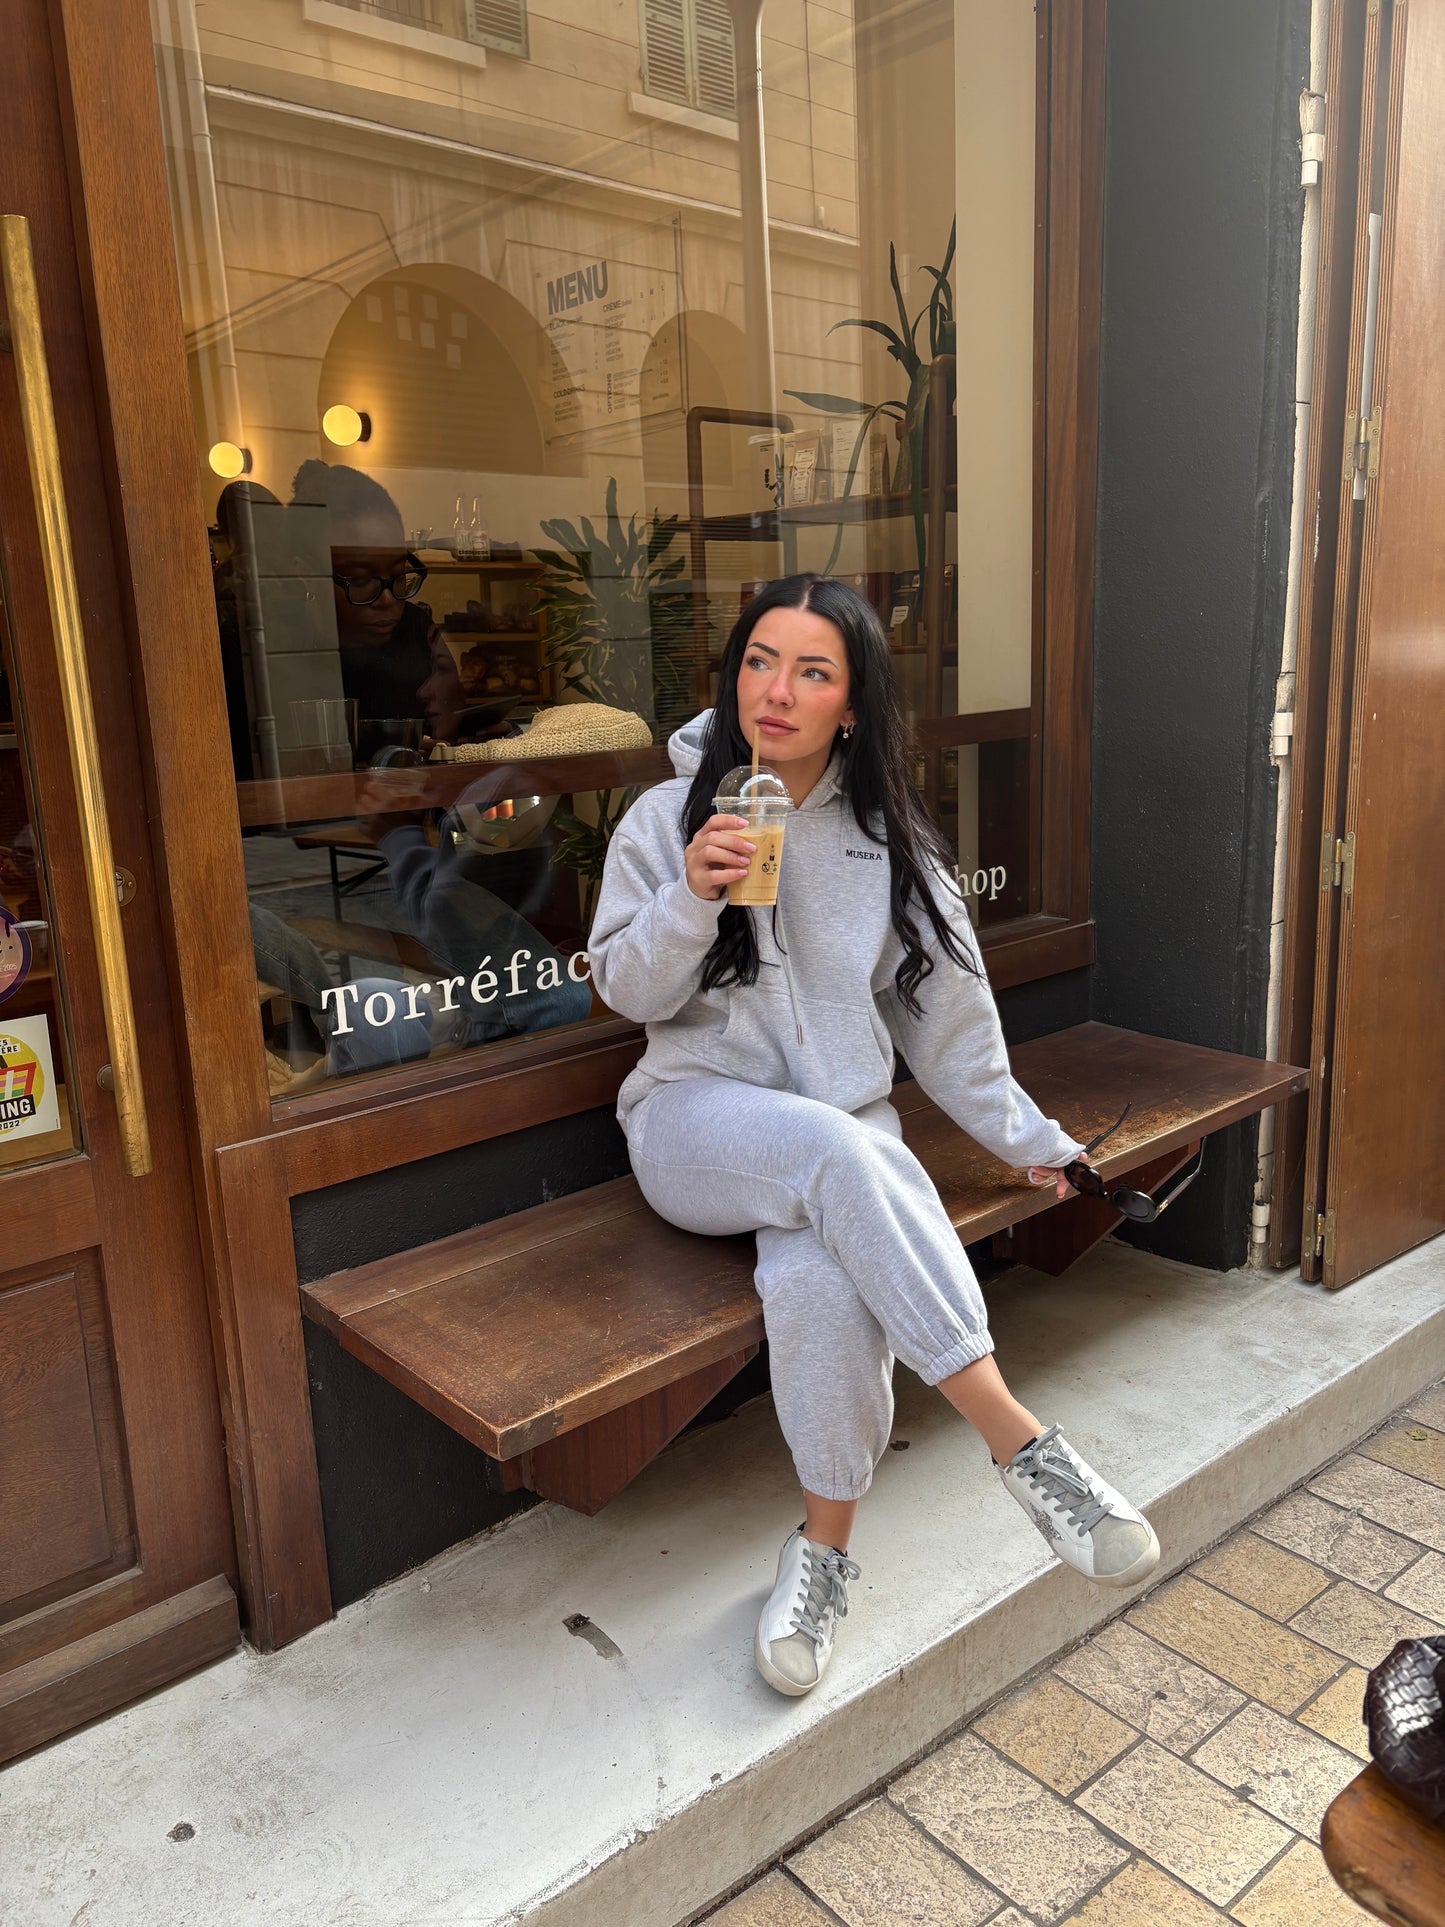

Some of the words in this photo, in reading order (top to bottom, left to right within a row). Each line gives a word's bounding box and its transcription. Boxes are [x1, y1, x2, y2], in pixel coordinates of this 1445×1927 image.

[547, 261, 608, 315] MENU
[845, 848, 883, 861] MUSERA
[321, 949, 591, 1036] Torréfac
